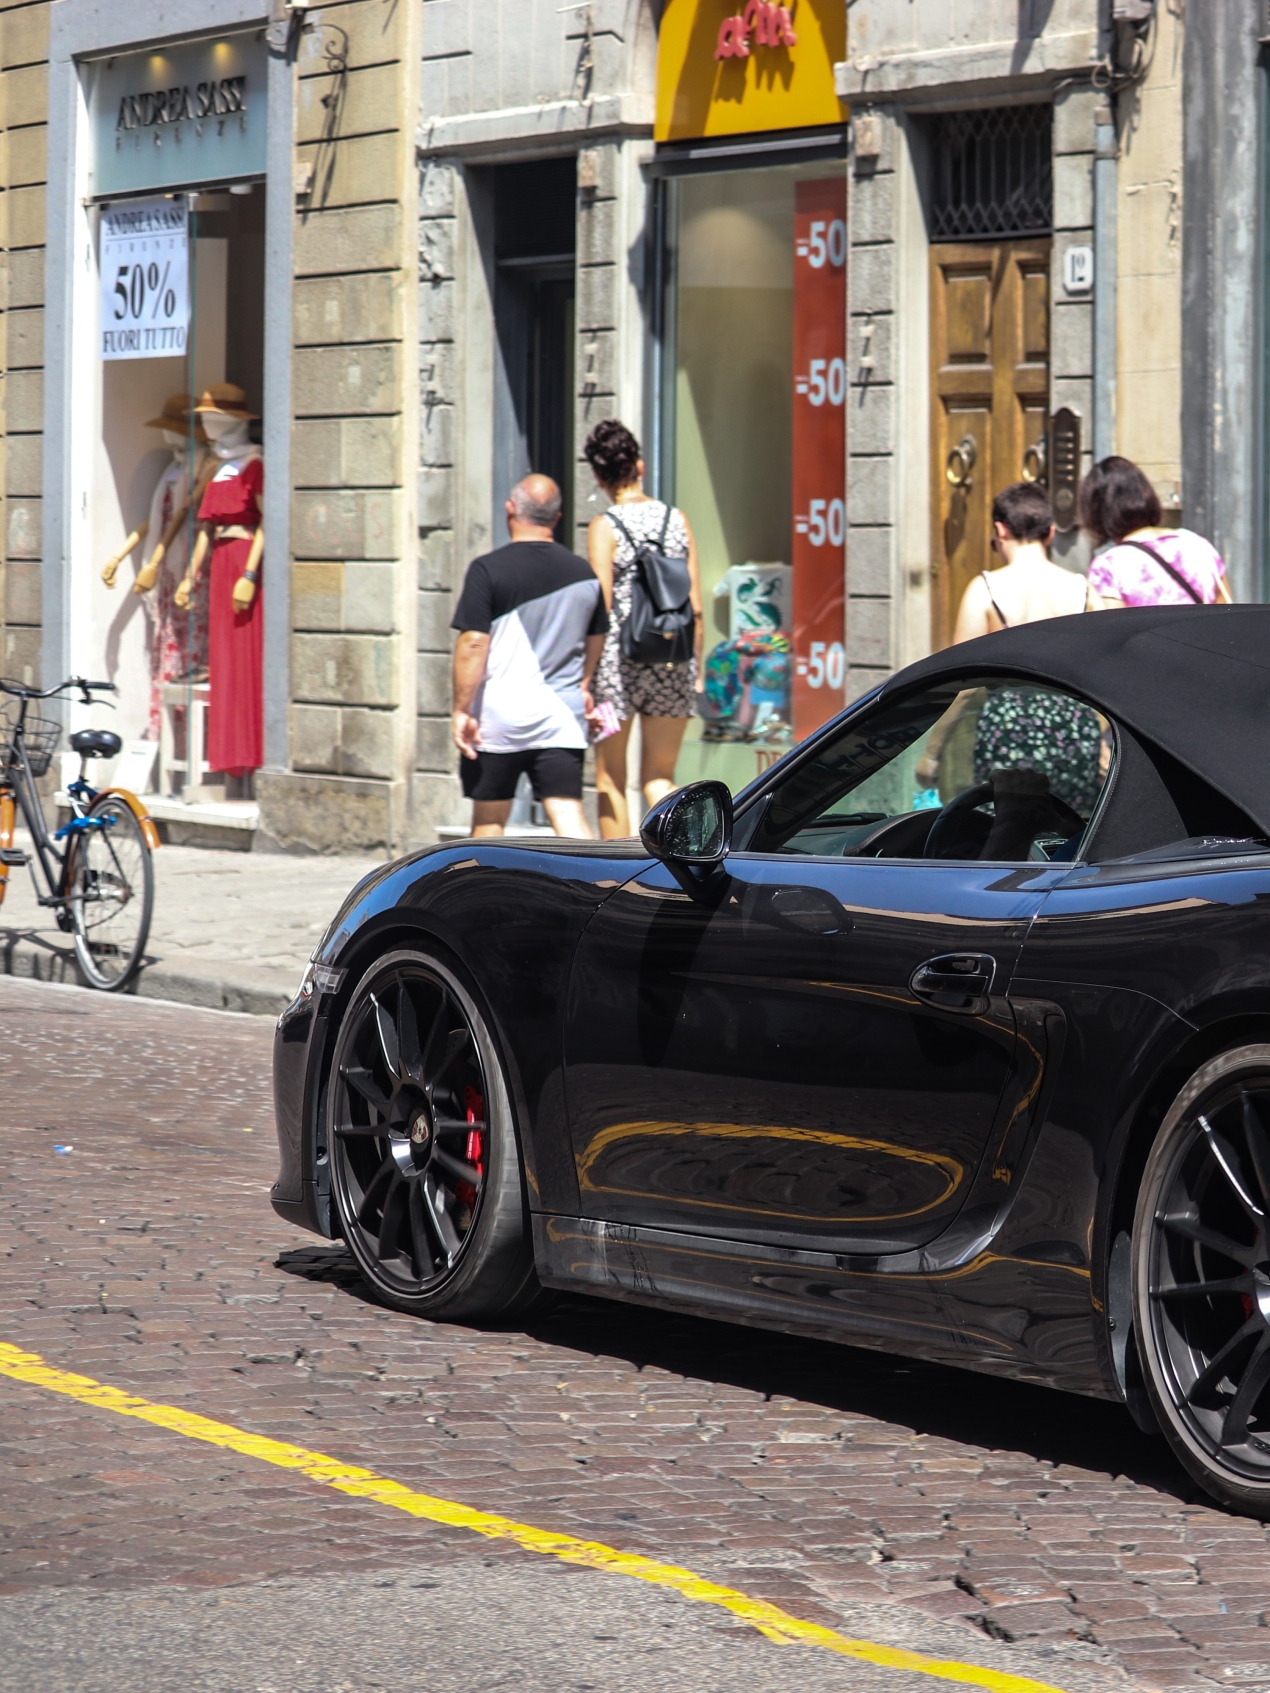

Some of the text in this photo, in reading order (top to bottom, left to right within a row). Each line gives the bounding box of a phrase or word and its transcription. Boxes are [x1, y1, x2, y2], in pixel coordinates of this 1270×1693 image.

[116, 75, 247, 132] ANDREA SASSI
[105, 210, 153, 236] ANDREA
[113, 260, 176, 321] 50%
[102, 326, 185, 354] FUORI TUTTO
